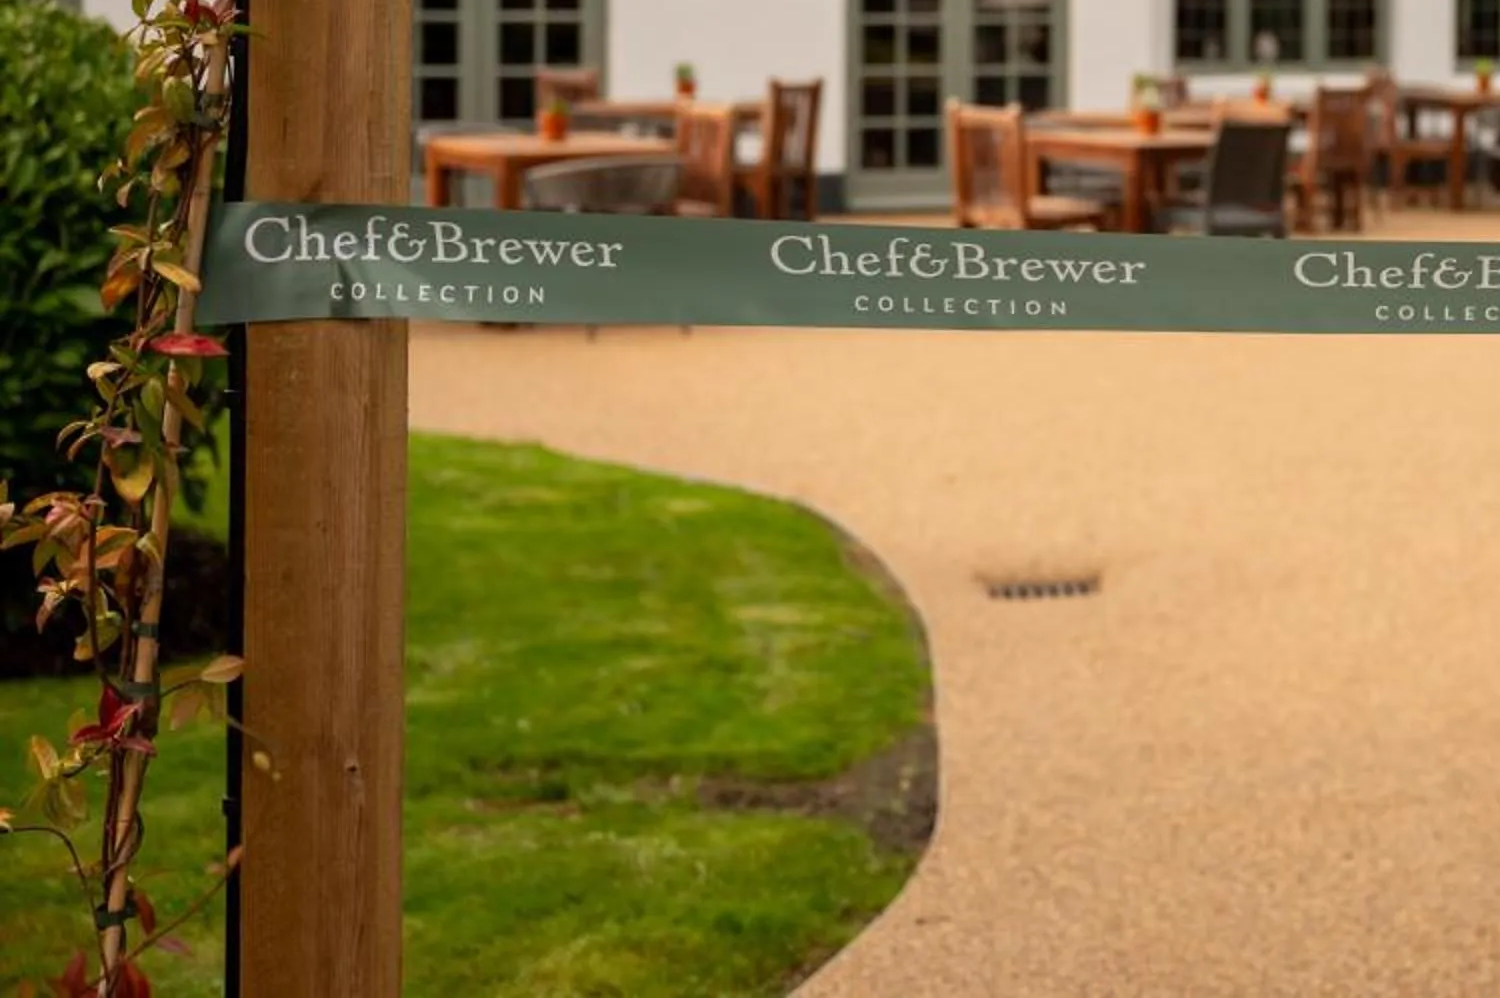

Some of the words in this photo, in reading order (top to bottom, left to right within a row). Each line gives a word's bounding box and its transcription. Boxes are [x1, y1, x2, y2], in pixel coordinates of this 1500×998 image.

[244, 215, 623, 268] Chef&Brewer
[770, 234, 1146, 285] Chef&Brewer
[330, 281, 545, 304] COLLECTION
[854, 294, 1067, 316] COLLECTION
